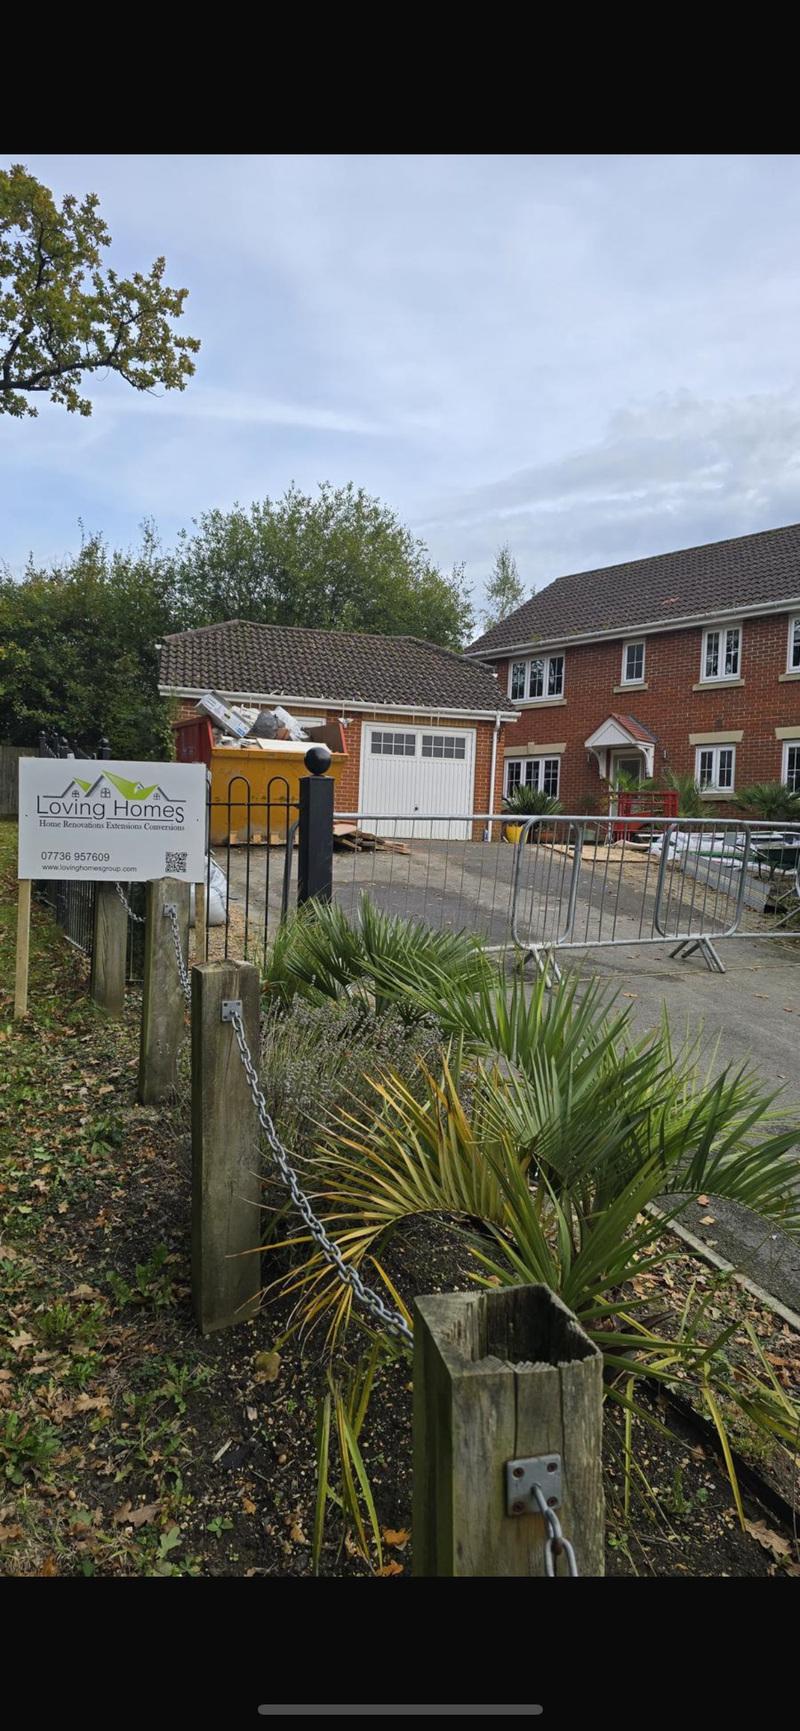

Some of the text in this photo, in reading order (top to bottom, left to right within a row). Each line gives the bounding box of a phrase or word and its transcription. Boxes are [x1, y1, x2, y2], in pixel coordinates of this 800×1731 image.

[36, 795, 185, 823] Loving Homes
[39, 820, 185, 831] Home Renovations Extensions Conversions
[41, 851, 110, 861] 07736 957609
[42, 864, 137, 873] www.lovinghomesgroup.com
